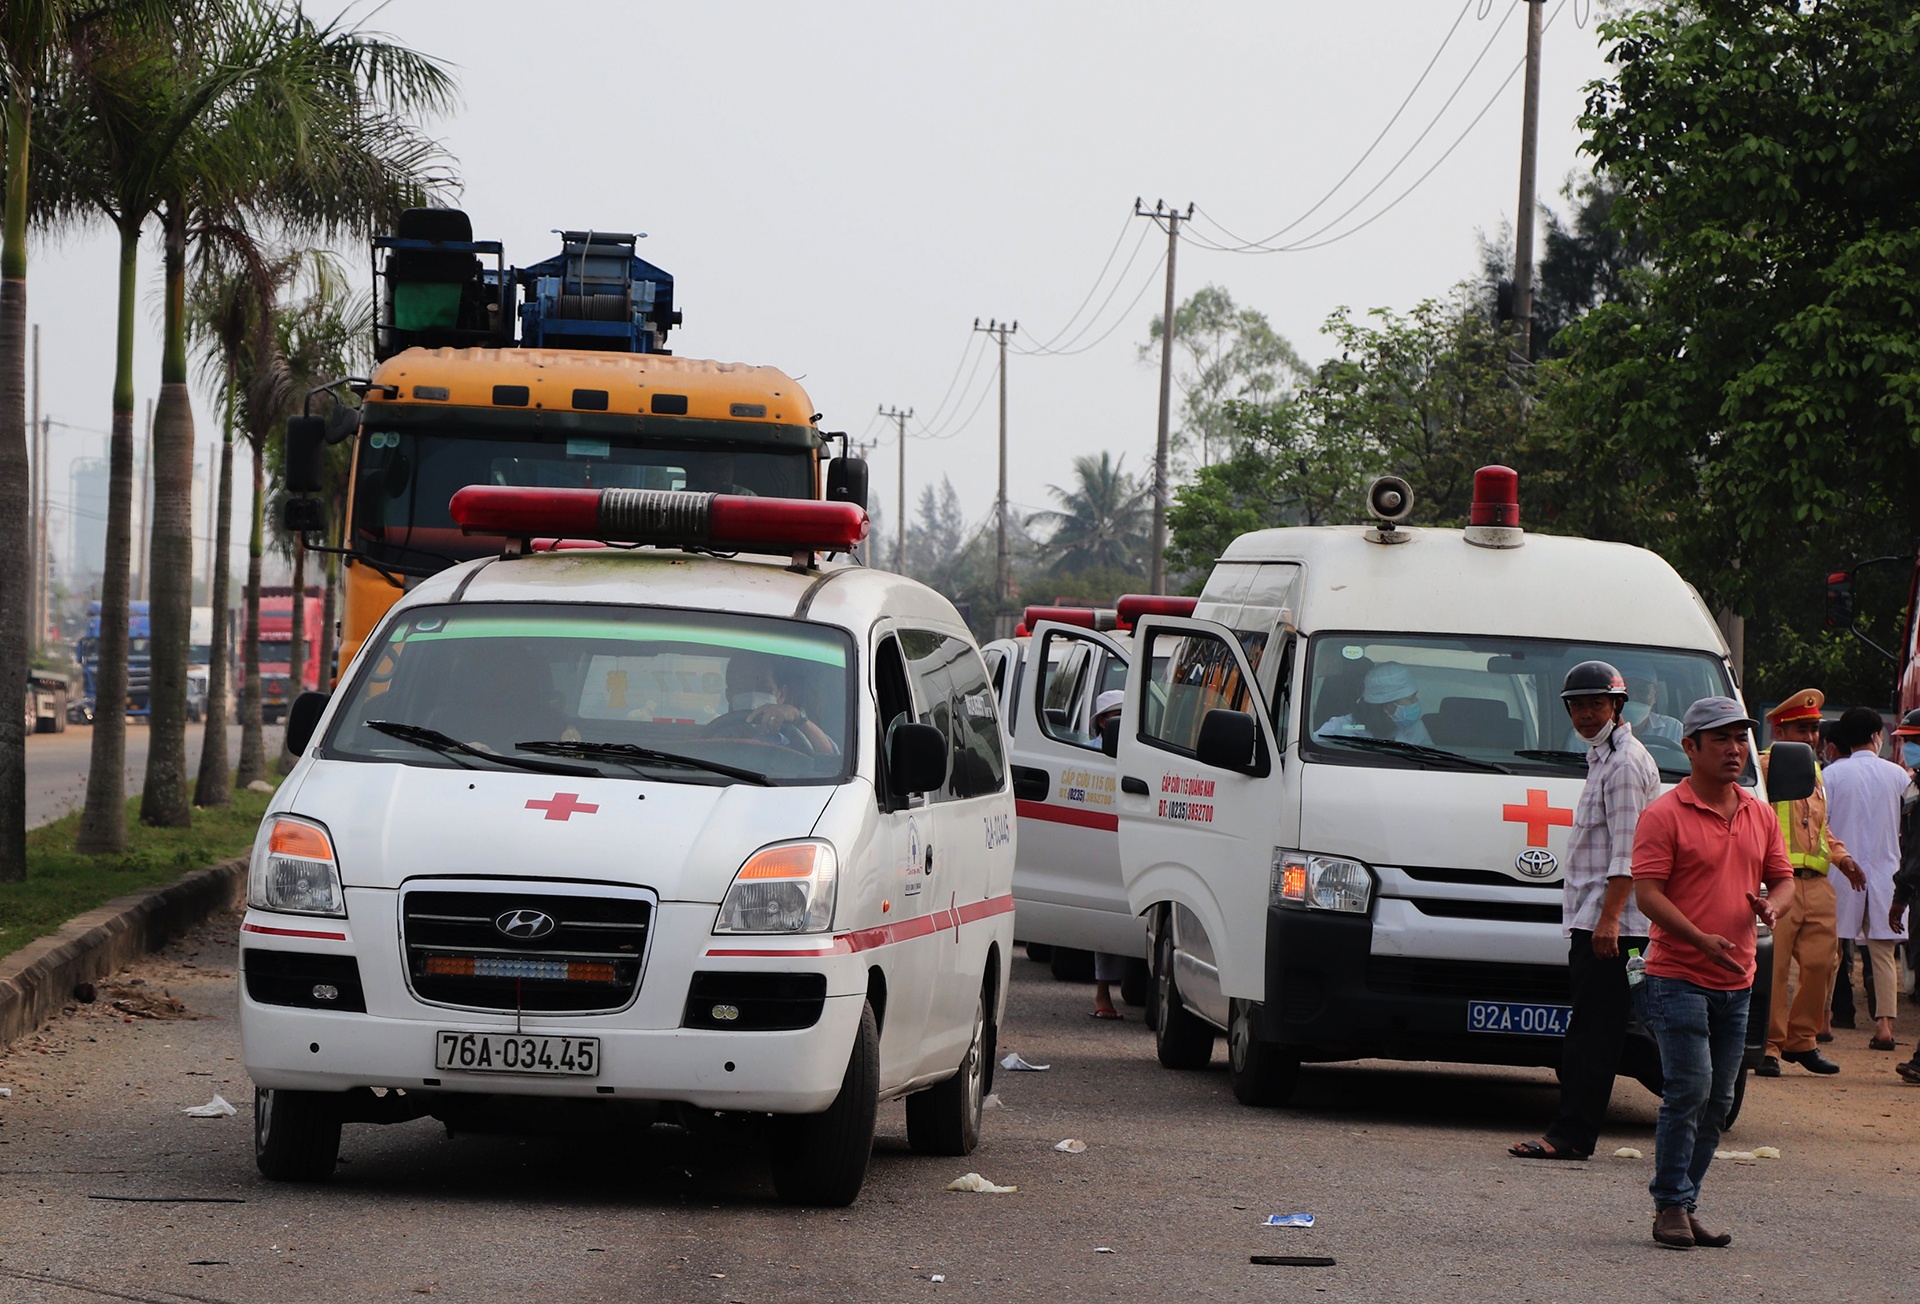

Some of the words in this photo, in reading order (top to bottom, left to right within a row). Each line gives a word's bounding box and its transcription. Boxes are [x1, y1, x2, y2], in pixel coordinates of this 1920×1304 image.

[1092, 775, 1105, 790] 115
[1180, 778, 1189, 795] 115
[1203, 780, 1216, 798] NAM
[442, 1034, 595, 1072] 76A-034.45
